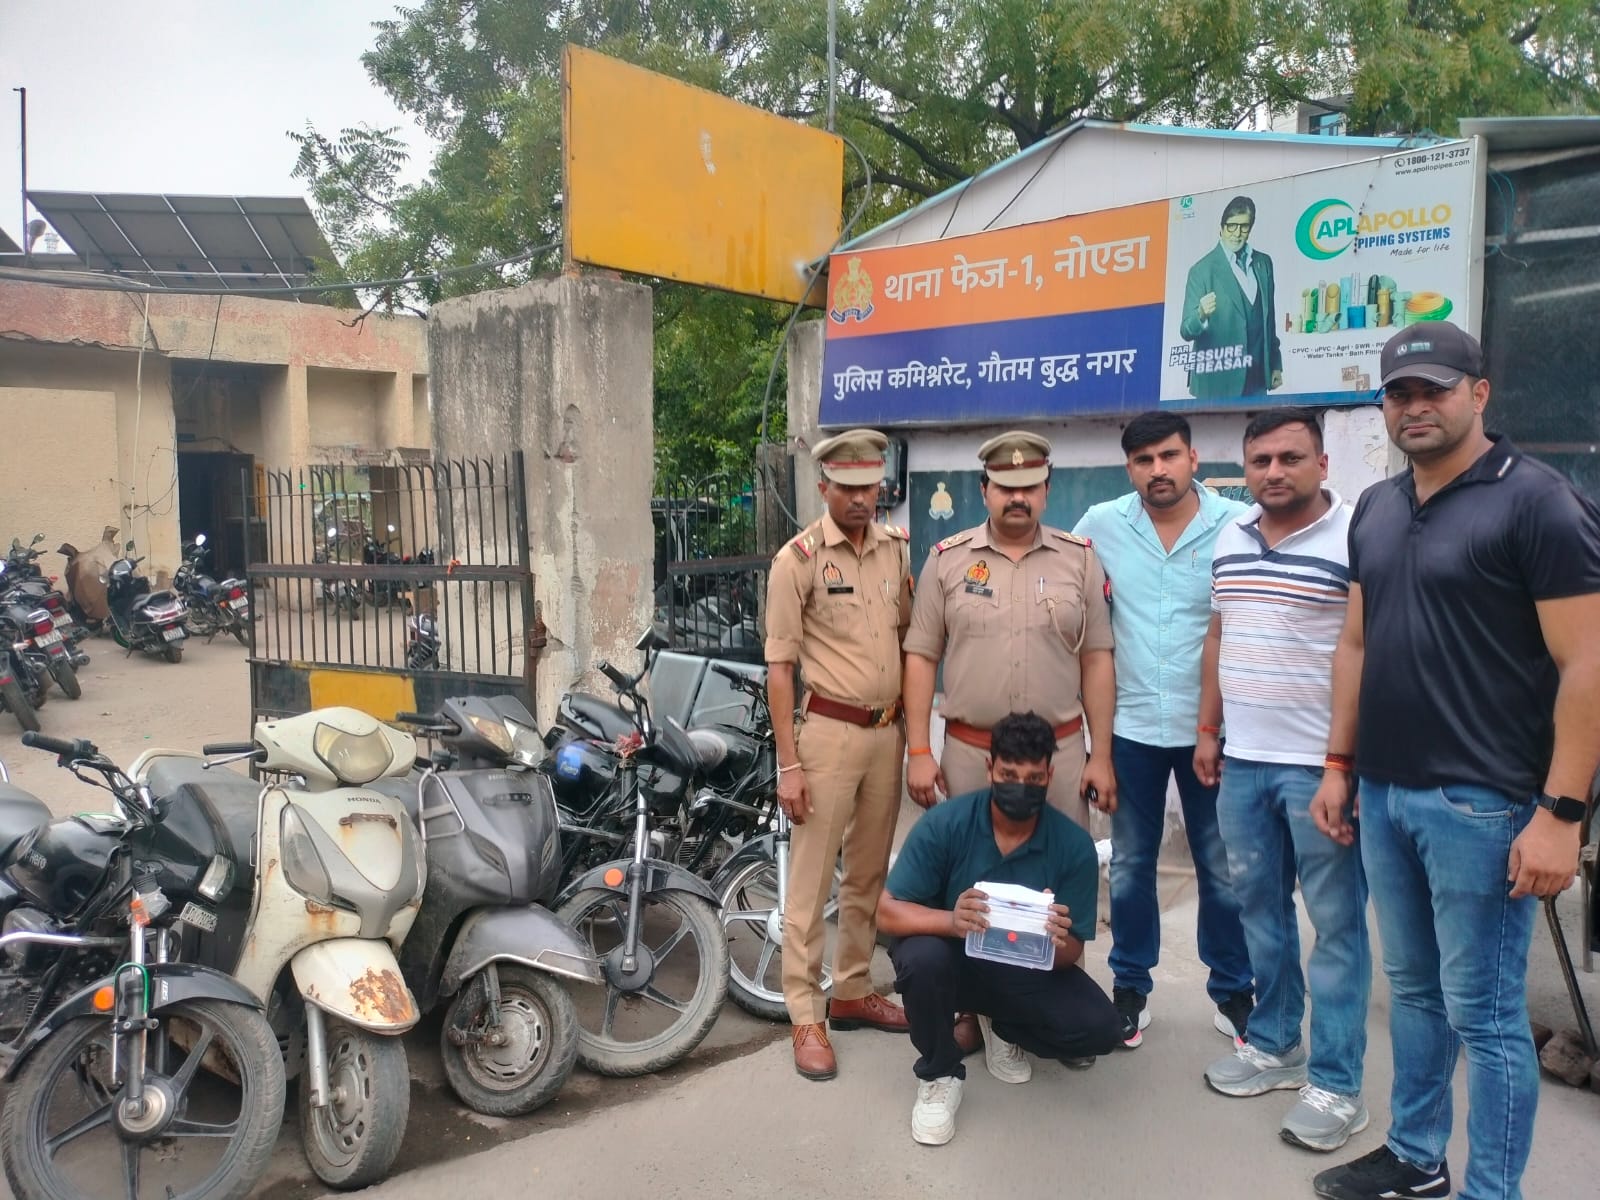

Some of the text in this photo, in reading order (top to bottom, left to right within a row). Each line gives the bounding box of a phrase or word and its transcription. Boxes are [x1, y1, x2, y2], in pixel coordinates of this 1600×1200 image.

[1406, 148, 1470, 166] 1800-121-3737
[1395, 160, 1470, 176] www.apollopipes.com
[1357, 203, 1452, 233] APOLLO
[1316, 217, 1358, 240] APL
[1357, 227, 1450, 249] PIPING SYSTEMS
[1390, 243, 1450, 256] Made for life
[884, 235, 1151, 302] थाना फेज-1, नोएडा
[1169, 345, 1244, 366] PRESSURE
[1171, 345, 1190, 355] HAR
[1314, 345, 1331, 353] uPVC
[1184, 355, 1253, 374] SE BEASAR
[833, 349, 1137, 401] पुलिस कमिश्नरेट, गौतम बुद्ध नगर
